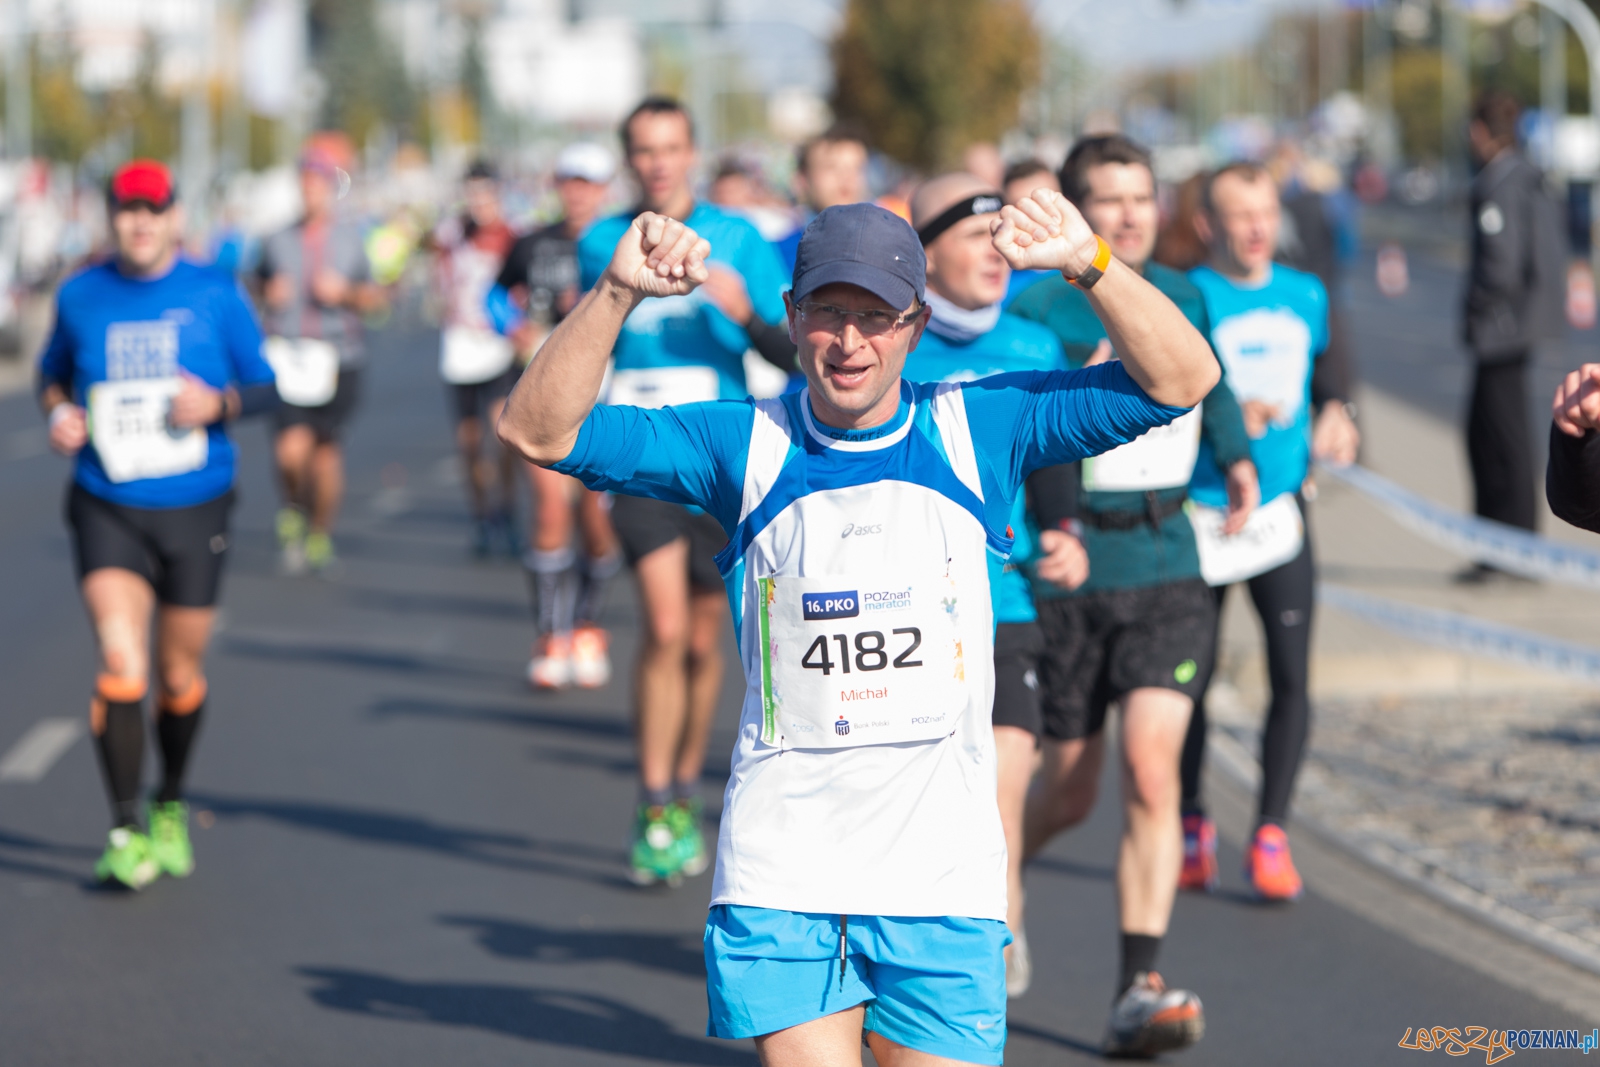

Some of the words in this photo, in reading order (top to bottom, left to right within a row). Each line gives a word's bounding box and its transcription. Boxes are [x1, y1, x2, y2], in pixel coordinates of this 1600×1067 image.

[830, 431, 876, 442] CRAFT
[854, 524, 882, 536] asics
[806, 600, 824, 613] 16.
[825, 597, 855, 613] PKO
[864, 599, 912, 611] maraton
[801, 626, 923, 676] 4182
[840, 687, 889, 702] Michał
[853, 722, 870, 730] Bank
[872, 719, 890, 728] Polski
